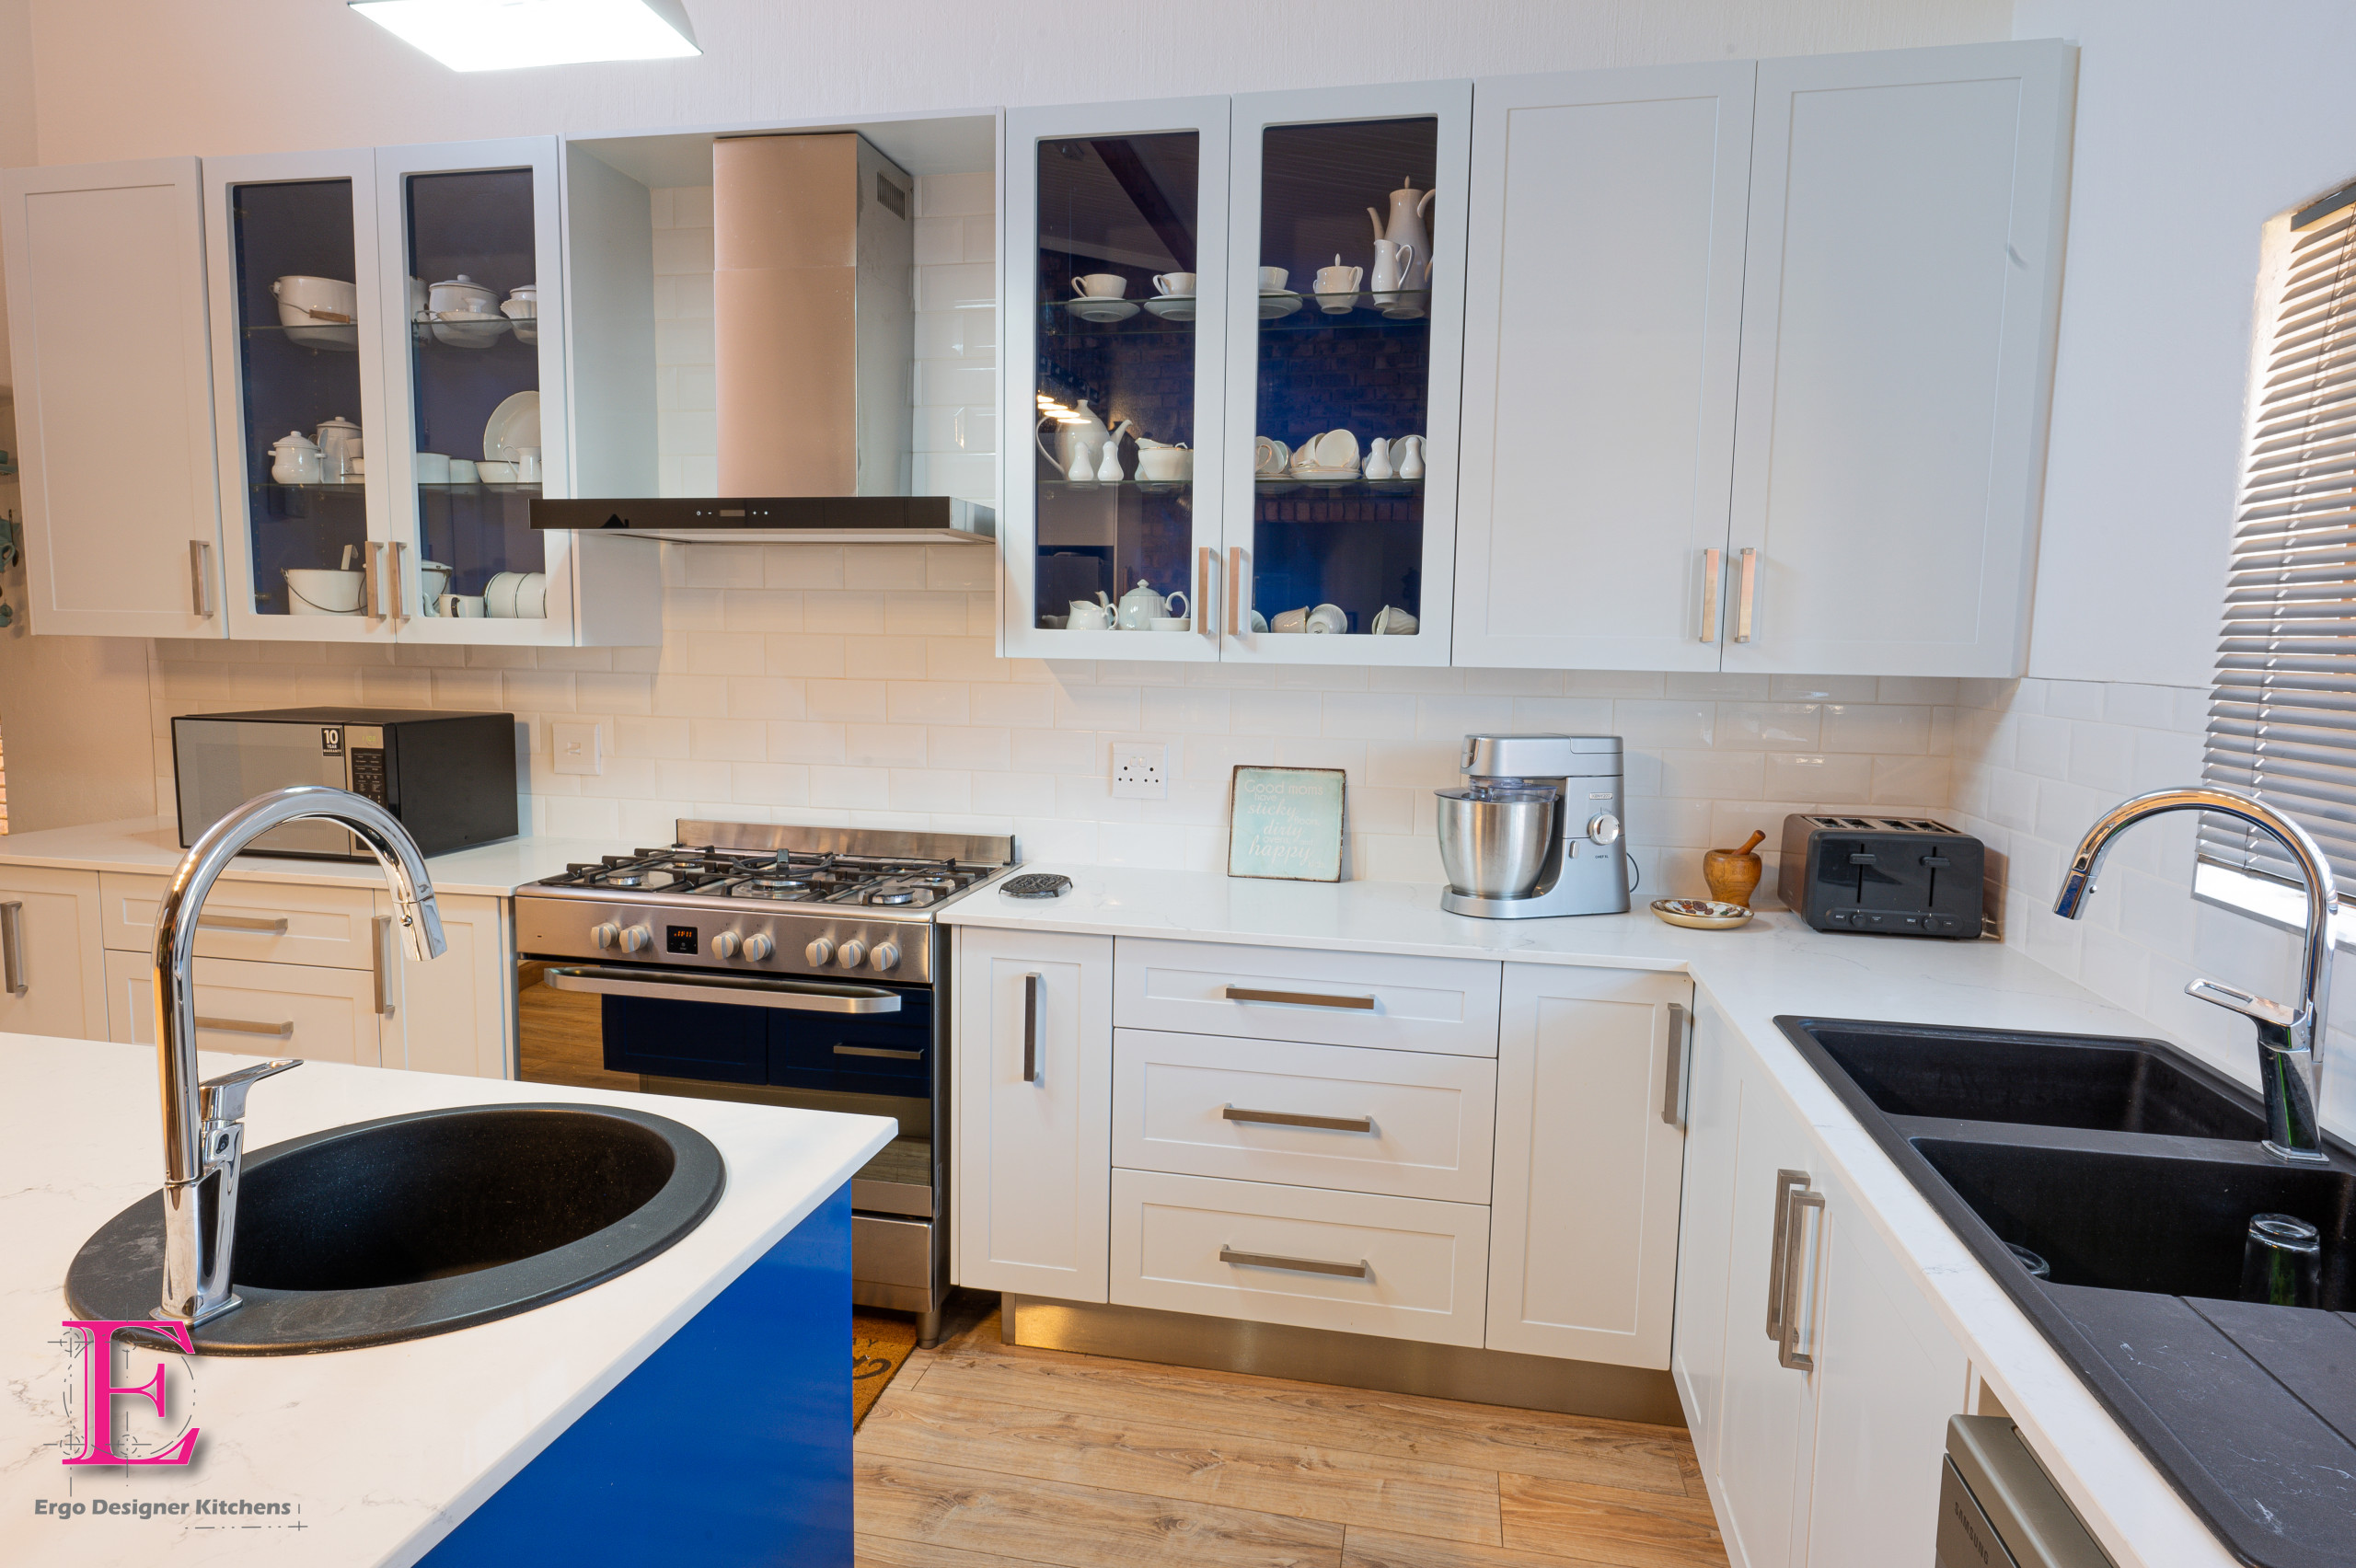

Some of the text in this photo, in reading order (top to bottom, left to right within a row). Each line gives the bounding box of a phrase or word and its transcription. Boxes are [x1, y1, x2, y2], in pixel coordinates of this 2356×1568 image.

[324, 729, 339, 744] 10
[1244, 779, 1323, 796] Good moms
[1254, 793, 1277, 801] have
[1247, 799, 1297, 822] sticky
[1264, 818, 1304, 842] dirty
[1248, 834, 1311, 867] happy
[1954, 1501, 1989, 1564] SAMSUNG
